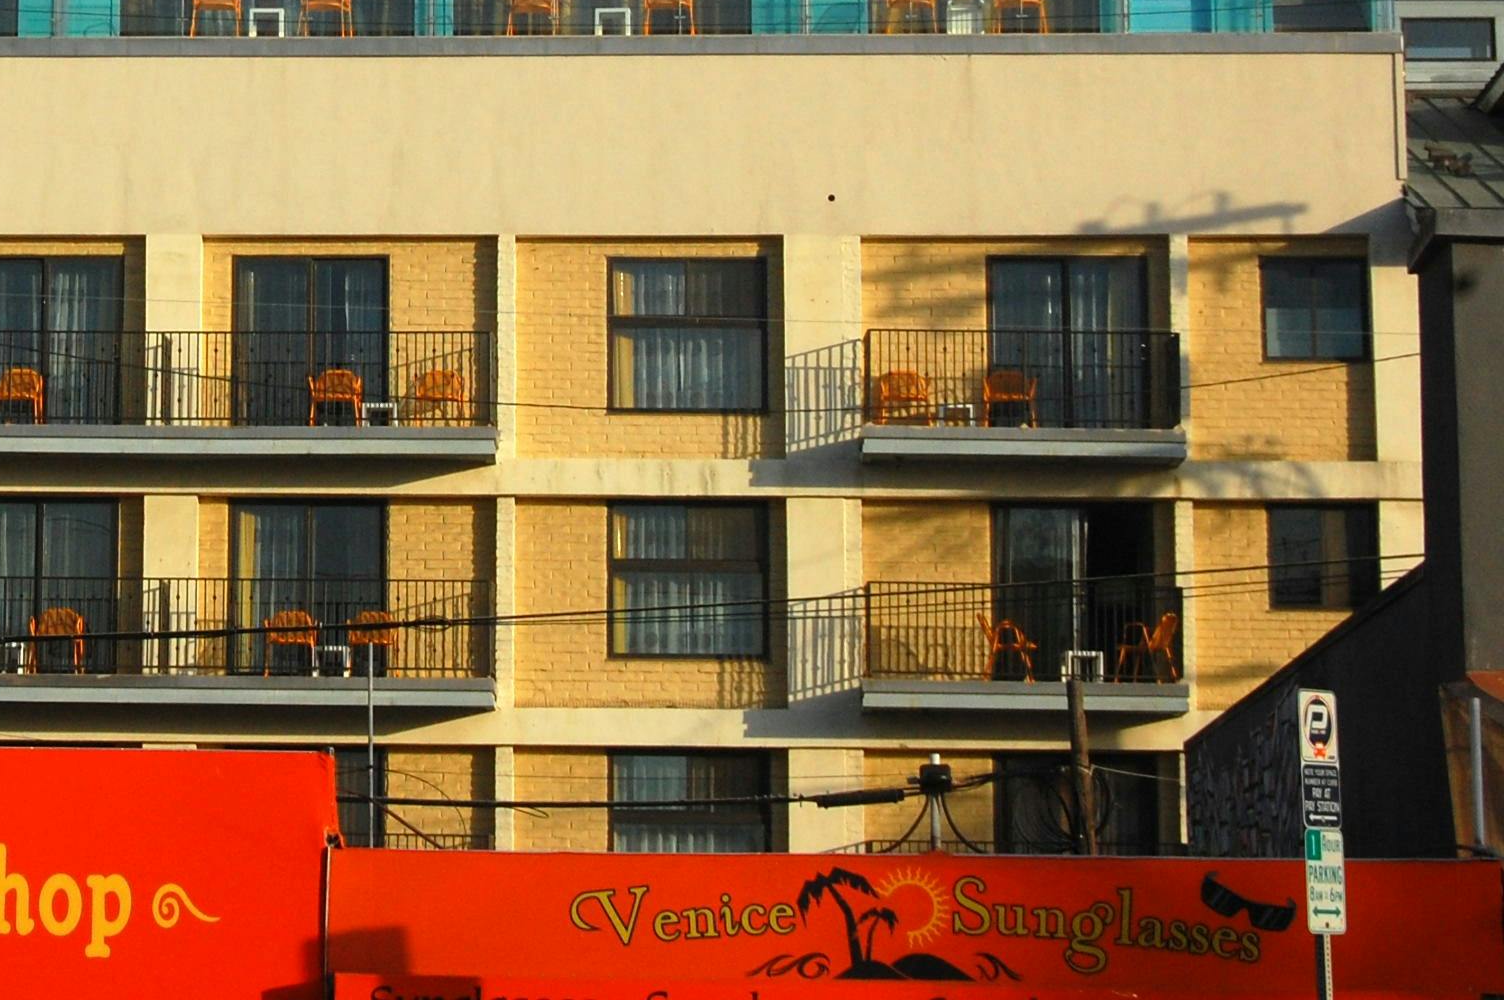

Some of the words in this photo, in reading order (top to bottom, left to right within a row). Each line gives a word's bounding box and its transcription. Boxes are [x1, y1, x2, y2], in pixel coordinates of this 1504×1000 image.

[1312, 787, 1322, 799] PAY
[1305, 800, 1316, 812] PAY
[1317, 801, 1341, 813] STATION
[1311, 834, 1316, 857] 1
[1308, 865, 1343, 885] PARKING
[569, 885, 797, 946] Venice
[952, 875, 1262, 975] Sunglasses
